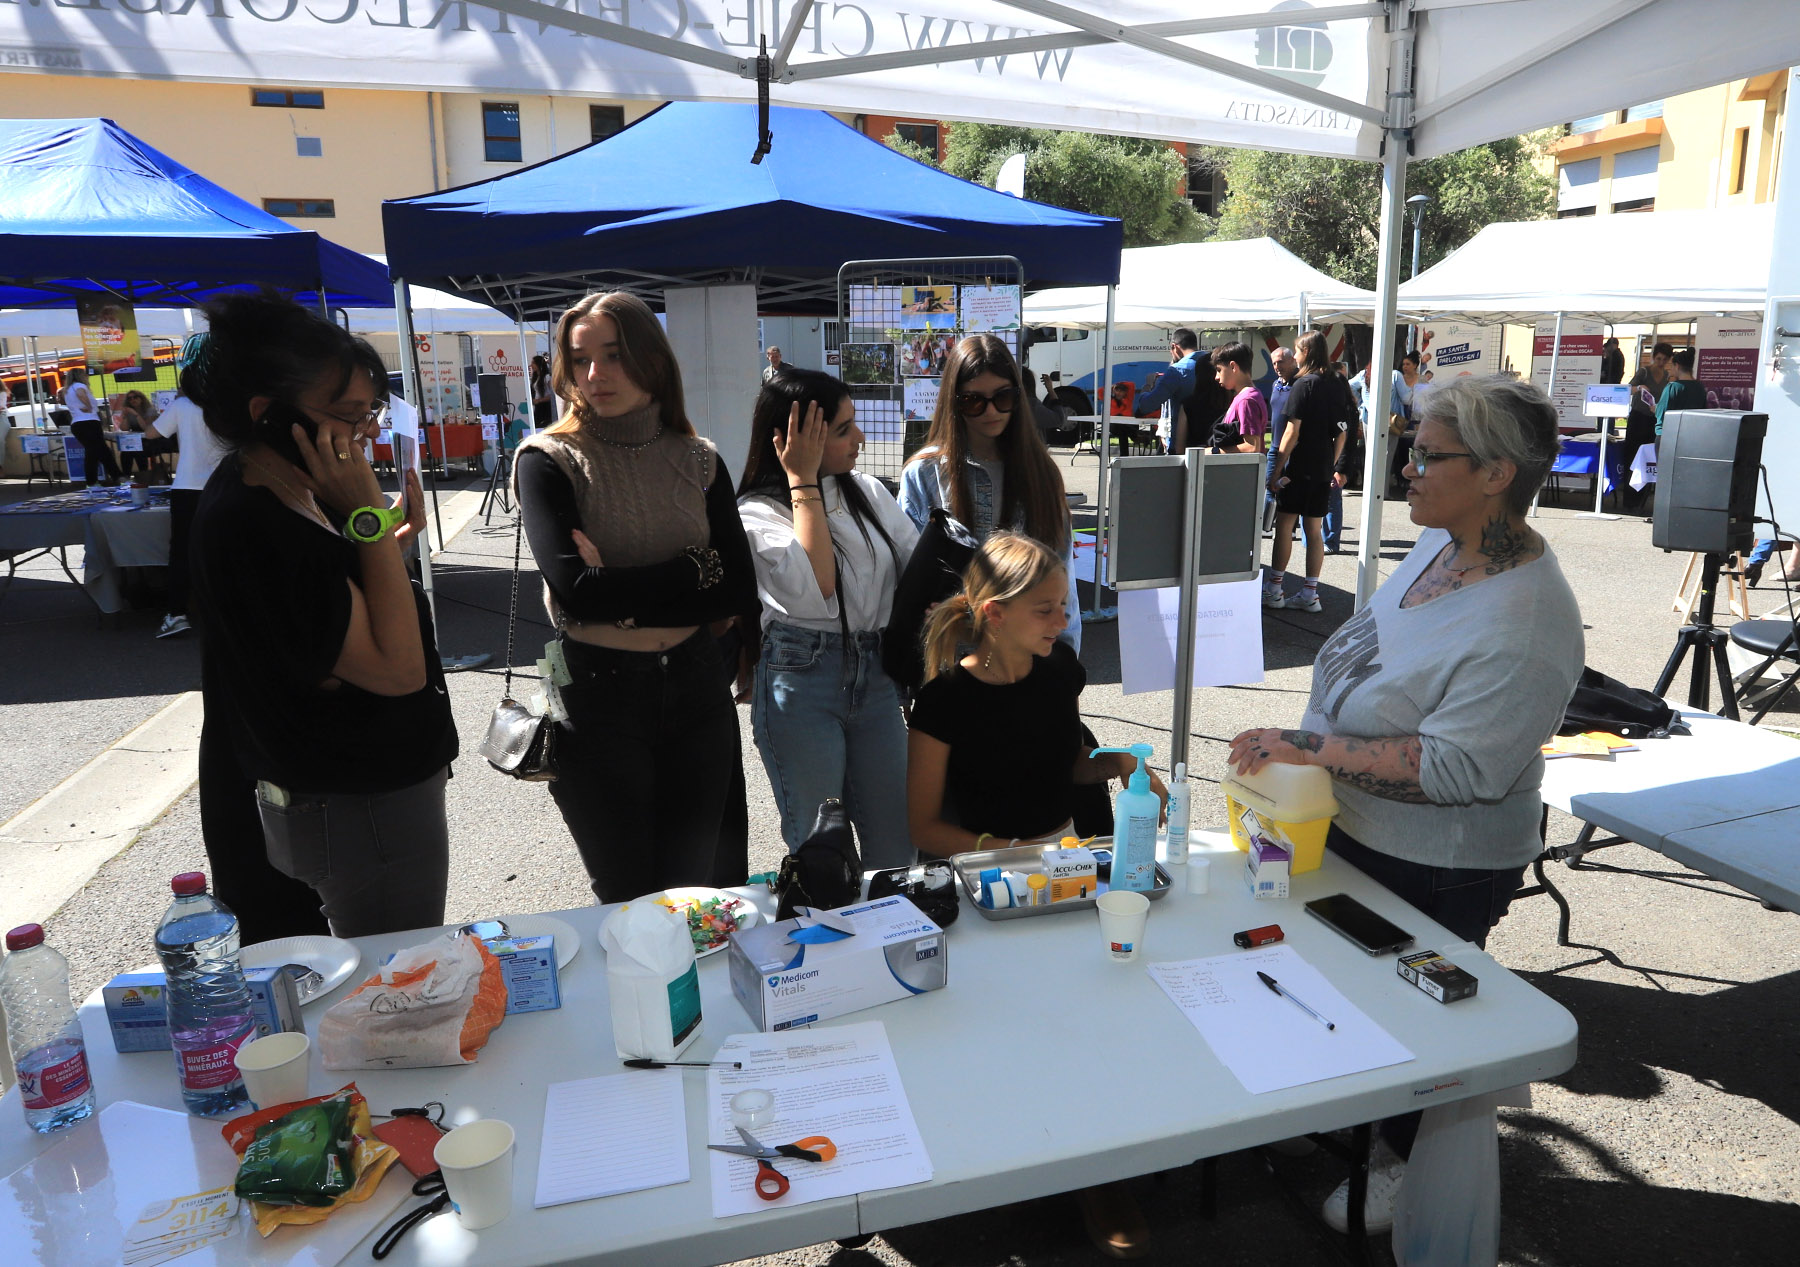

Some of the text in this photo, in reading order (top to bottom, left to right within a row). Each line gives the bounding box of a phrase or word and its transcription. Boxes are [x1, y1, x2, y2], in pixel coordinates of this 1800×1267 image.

[1591, 395, 1613, 403] Carsat
[1053, 863, 1093, 873] ACCU-CHEK
[883, 927, 922, 940] Medicom
[781, 970, 819, 985] Medicom
[1422, 976, 1440, 991] Fumer
[771, 983, 806, 999] Vitals
[186, 1049, 229, 1064] BUVEZ DES
[187, 1059, 231, 1072] MINÉRAUX.
[1414, 1088, 1434, 1096] France
[204, 1191, 230, 1202] MOMENT
[168, 1201, 230, 1231] 3114
